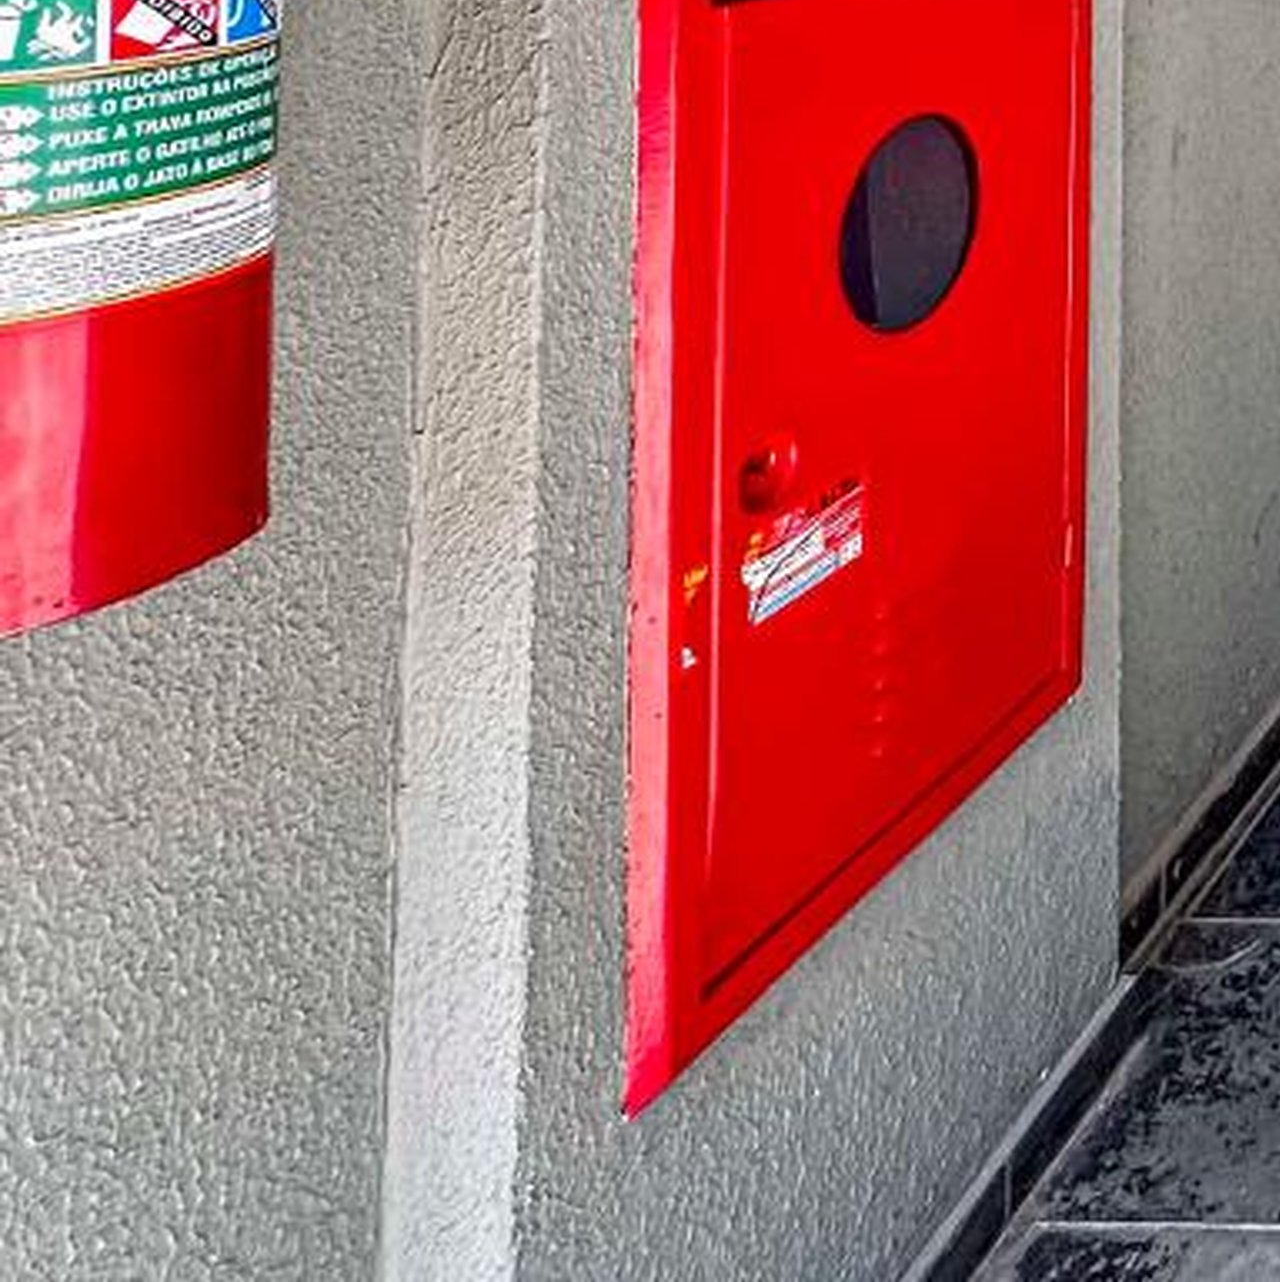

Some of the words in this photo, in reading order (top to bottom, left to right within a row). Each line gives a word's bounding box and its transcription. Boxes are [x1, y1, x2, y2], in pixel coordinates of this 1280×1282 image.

[49, 67, 191, 102] INSTRUÇÕES
[50, 99, 95, 121] USE
[102, 98, 117, 115] O
[122, 84, 207, 113] EXTINTOR
[49, 125, 108, 150] PUXE
[113, 124, 129, 141] A
[135, 114, 191, 138] TRAVA
[48, 151, 130, 177] APERTE
[136, 147, 151, 164] O
[124, 173, 138, 190] O
